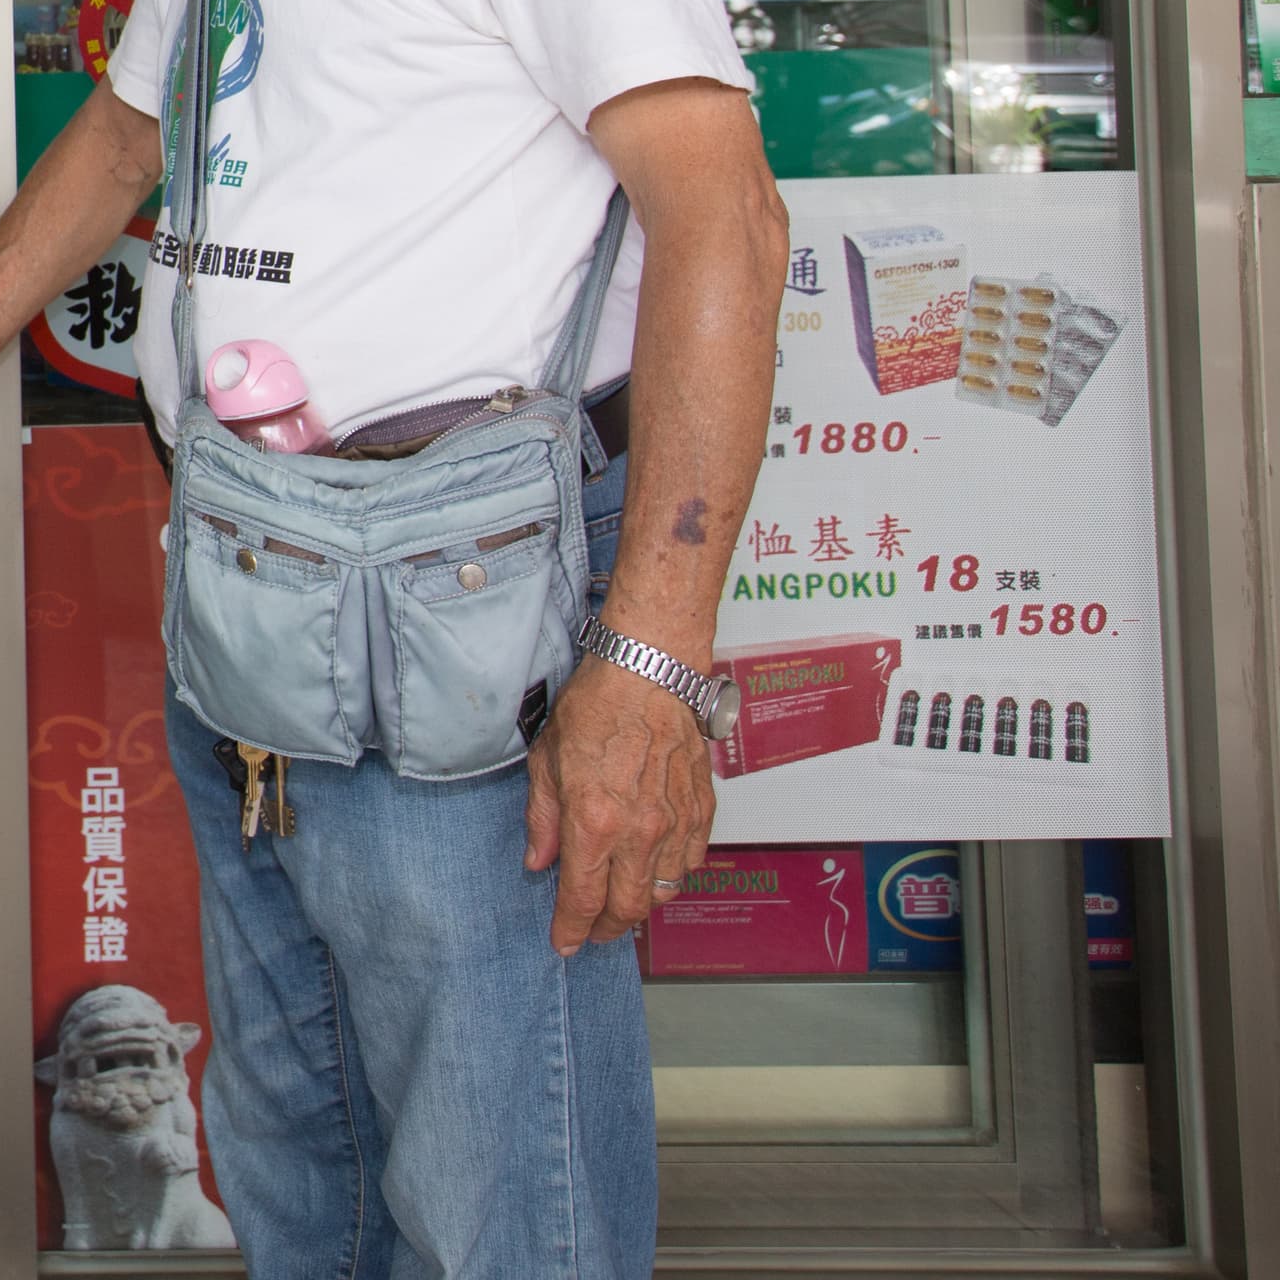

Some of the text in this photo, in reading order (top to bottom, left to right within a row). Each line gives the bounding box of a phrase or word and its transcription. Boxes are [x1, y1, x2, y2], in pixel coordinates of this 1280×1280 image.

[777, 311, 822, 333] 300
[747, 513, 913, 563] 恤基素
[721, 570, 898, 602] ANGPOKU
[916, 554, 1041, 593] 18 支裝
[745, 663, 845, 697] YANGPOKU
[81, 765, 128, 964] 品質保證
[679, 869, 779, 894] NGPOKU
